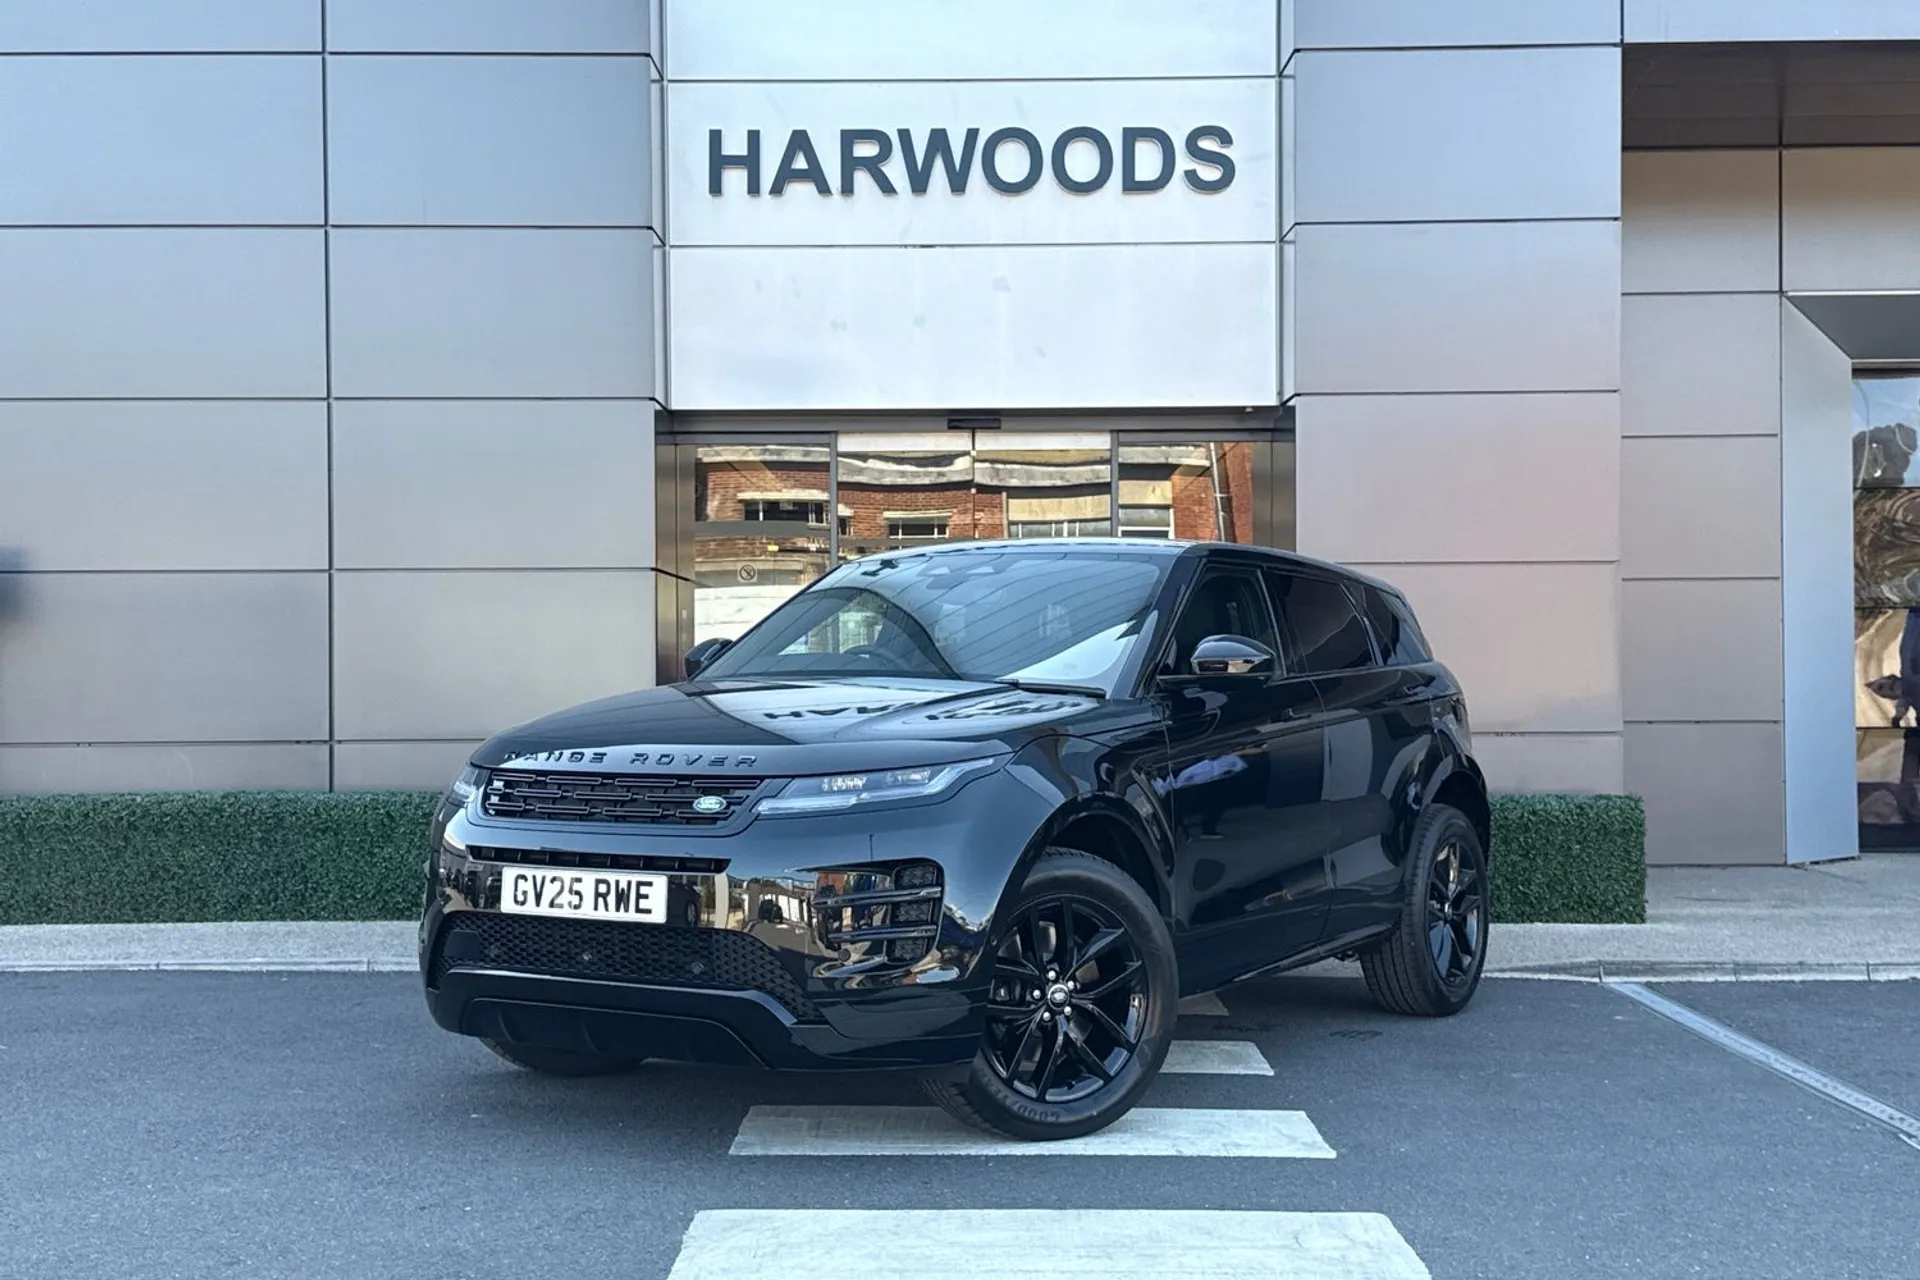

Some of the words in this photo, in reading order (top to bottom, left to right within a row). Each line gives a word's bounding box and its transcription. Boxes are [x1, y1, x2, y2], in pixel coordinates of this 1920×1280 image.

[707, 125, 1237, 197] HARWOODS
[503, 750, 608, 764] RANGE
[629, 753, 758, 768] ROVER
[513, 874, 584, 910] GV25
[593, 878, 654, 914] RWE
